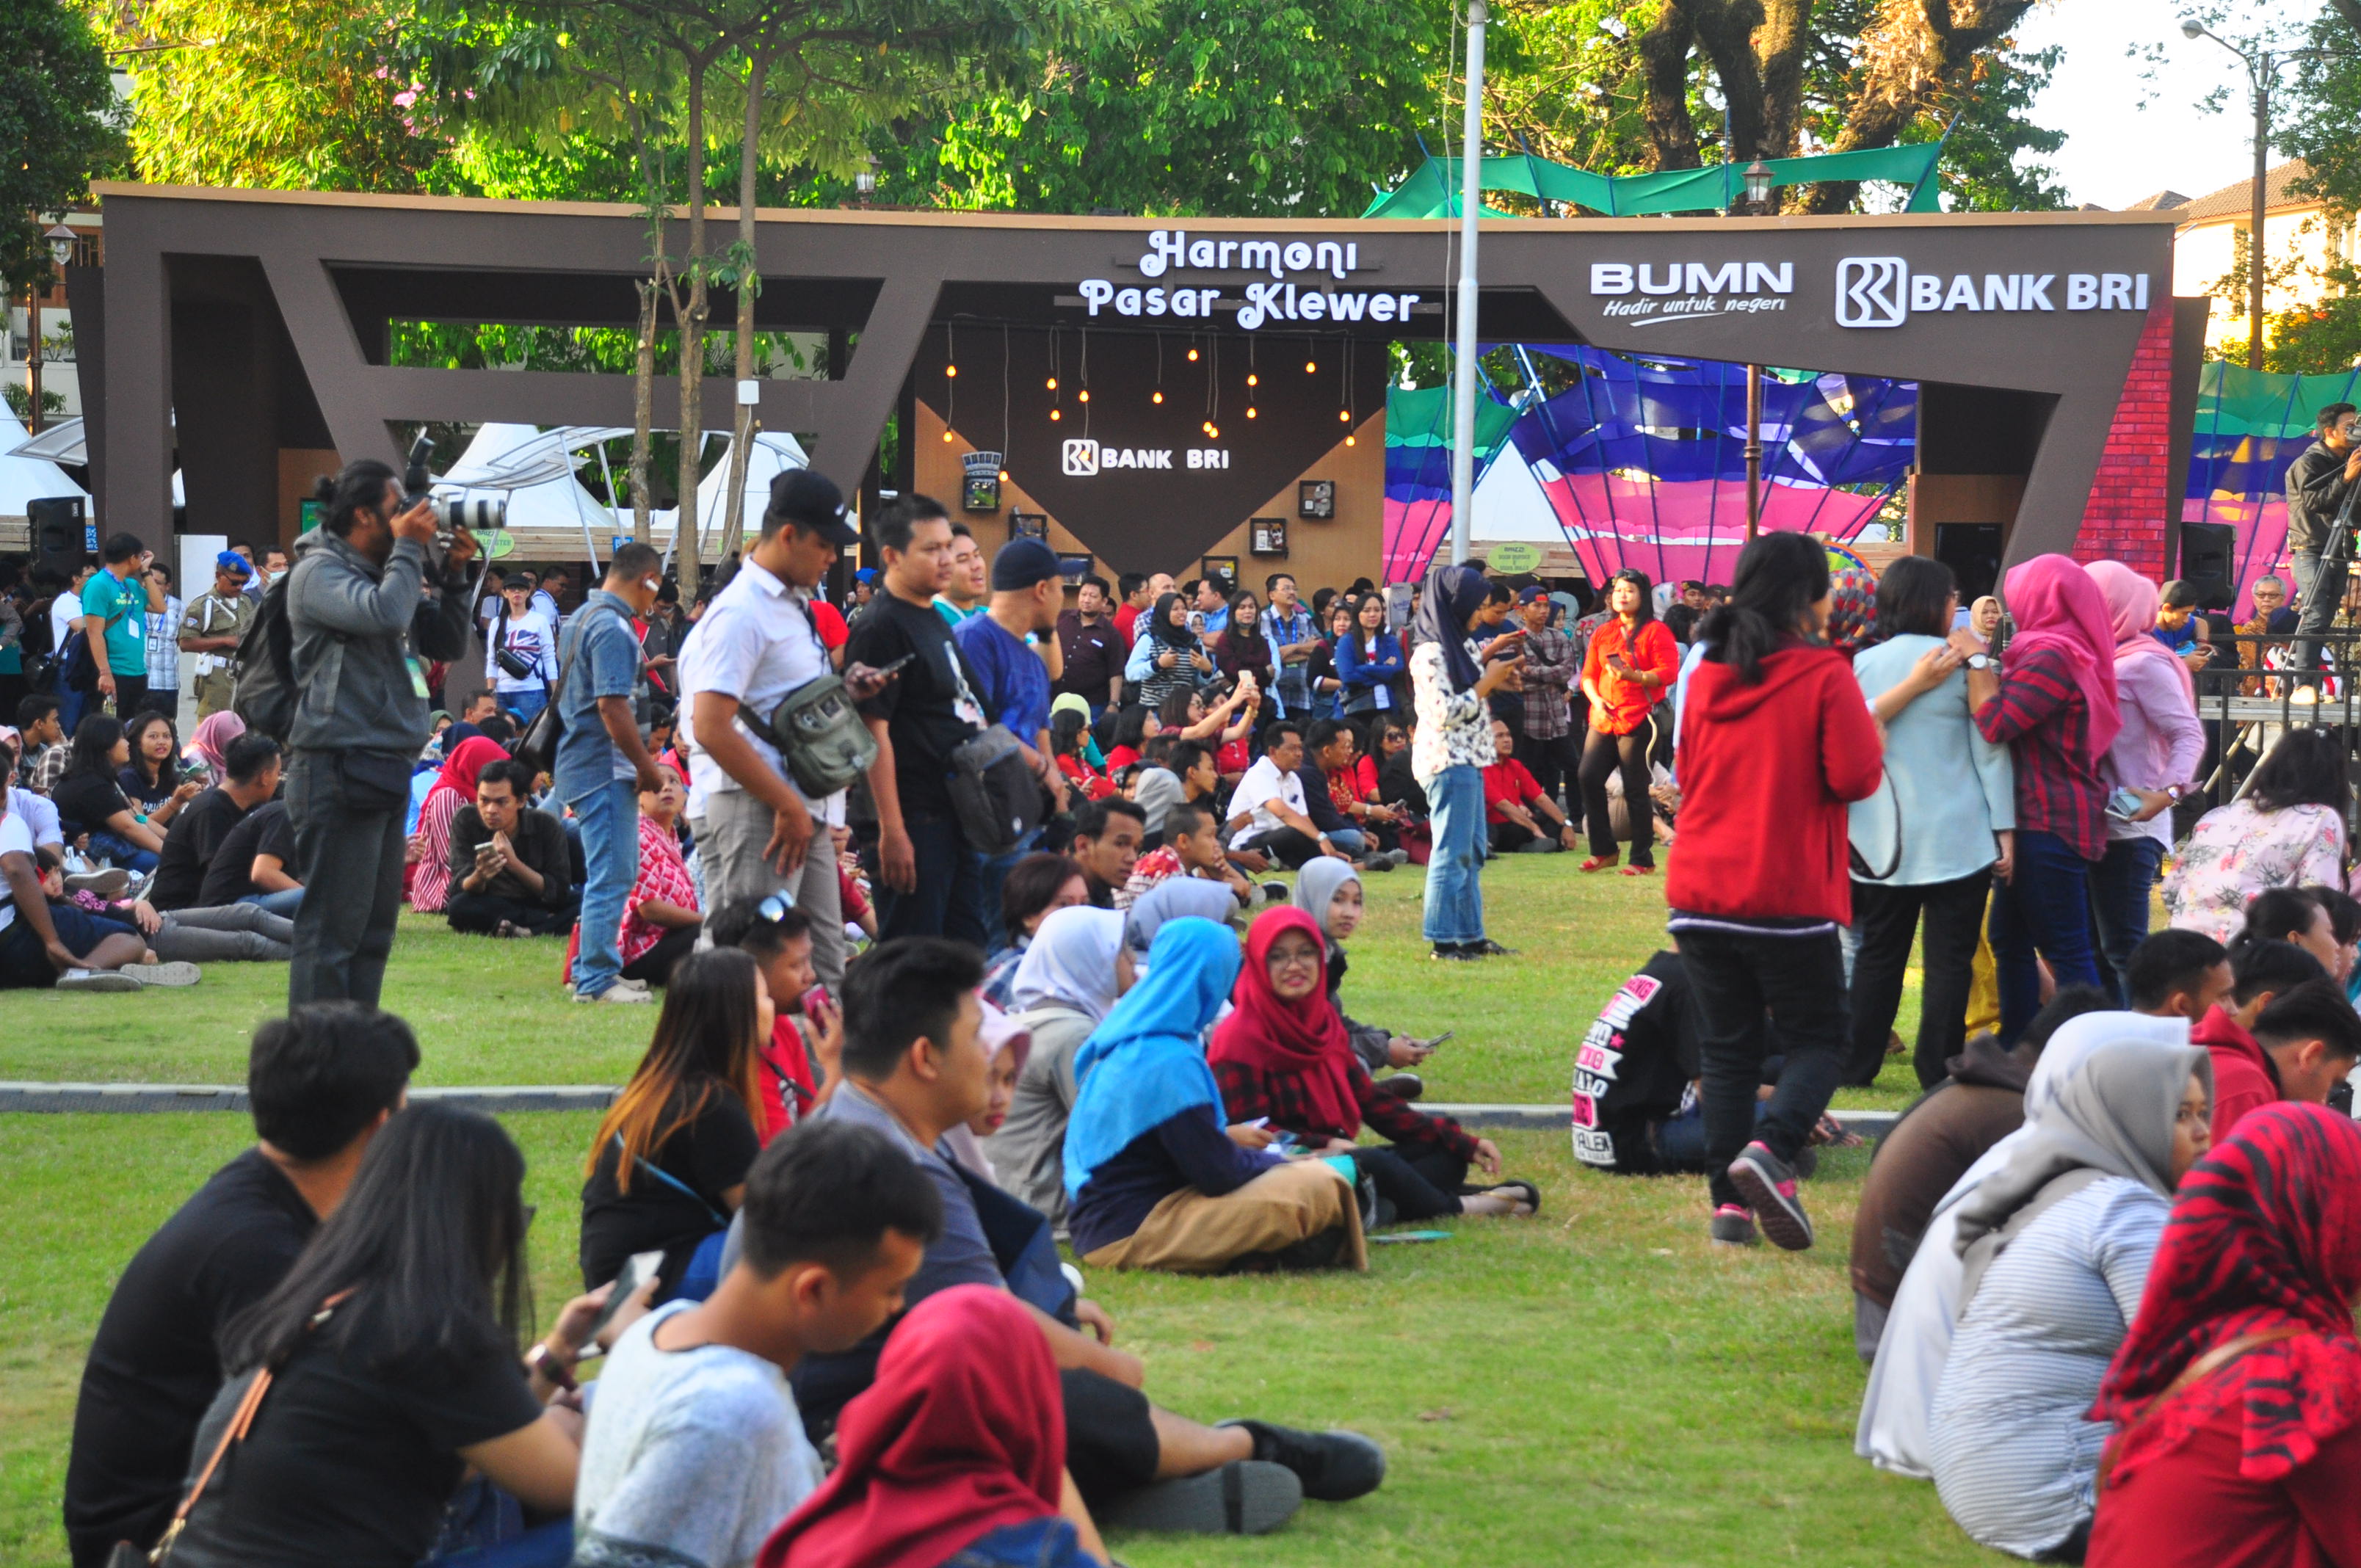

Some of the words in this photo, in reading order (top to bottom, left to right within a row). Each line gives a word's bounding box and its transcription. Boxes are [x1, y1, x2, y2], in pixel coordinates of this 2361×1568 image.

[1139, 230, 1357, 279] Harmoni
[1589, 261, 1793, 294] BUMN
[1911, 274, 2056, 311] BANK
[2067, 273, 2148, 310] BRI
[1078, 279, 1221, 316] Pasar
[1237, 283, 1420, 330] Klewer
[1603, 297, 1658, 316] Hadir
[1662, 295, 1716, 313] untuk
[1724, 297, 1785, 314] negeri
[1101, 448, 1172, 469] BANK
[1186, 448, 1229, 469] BRI
